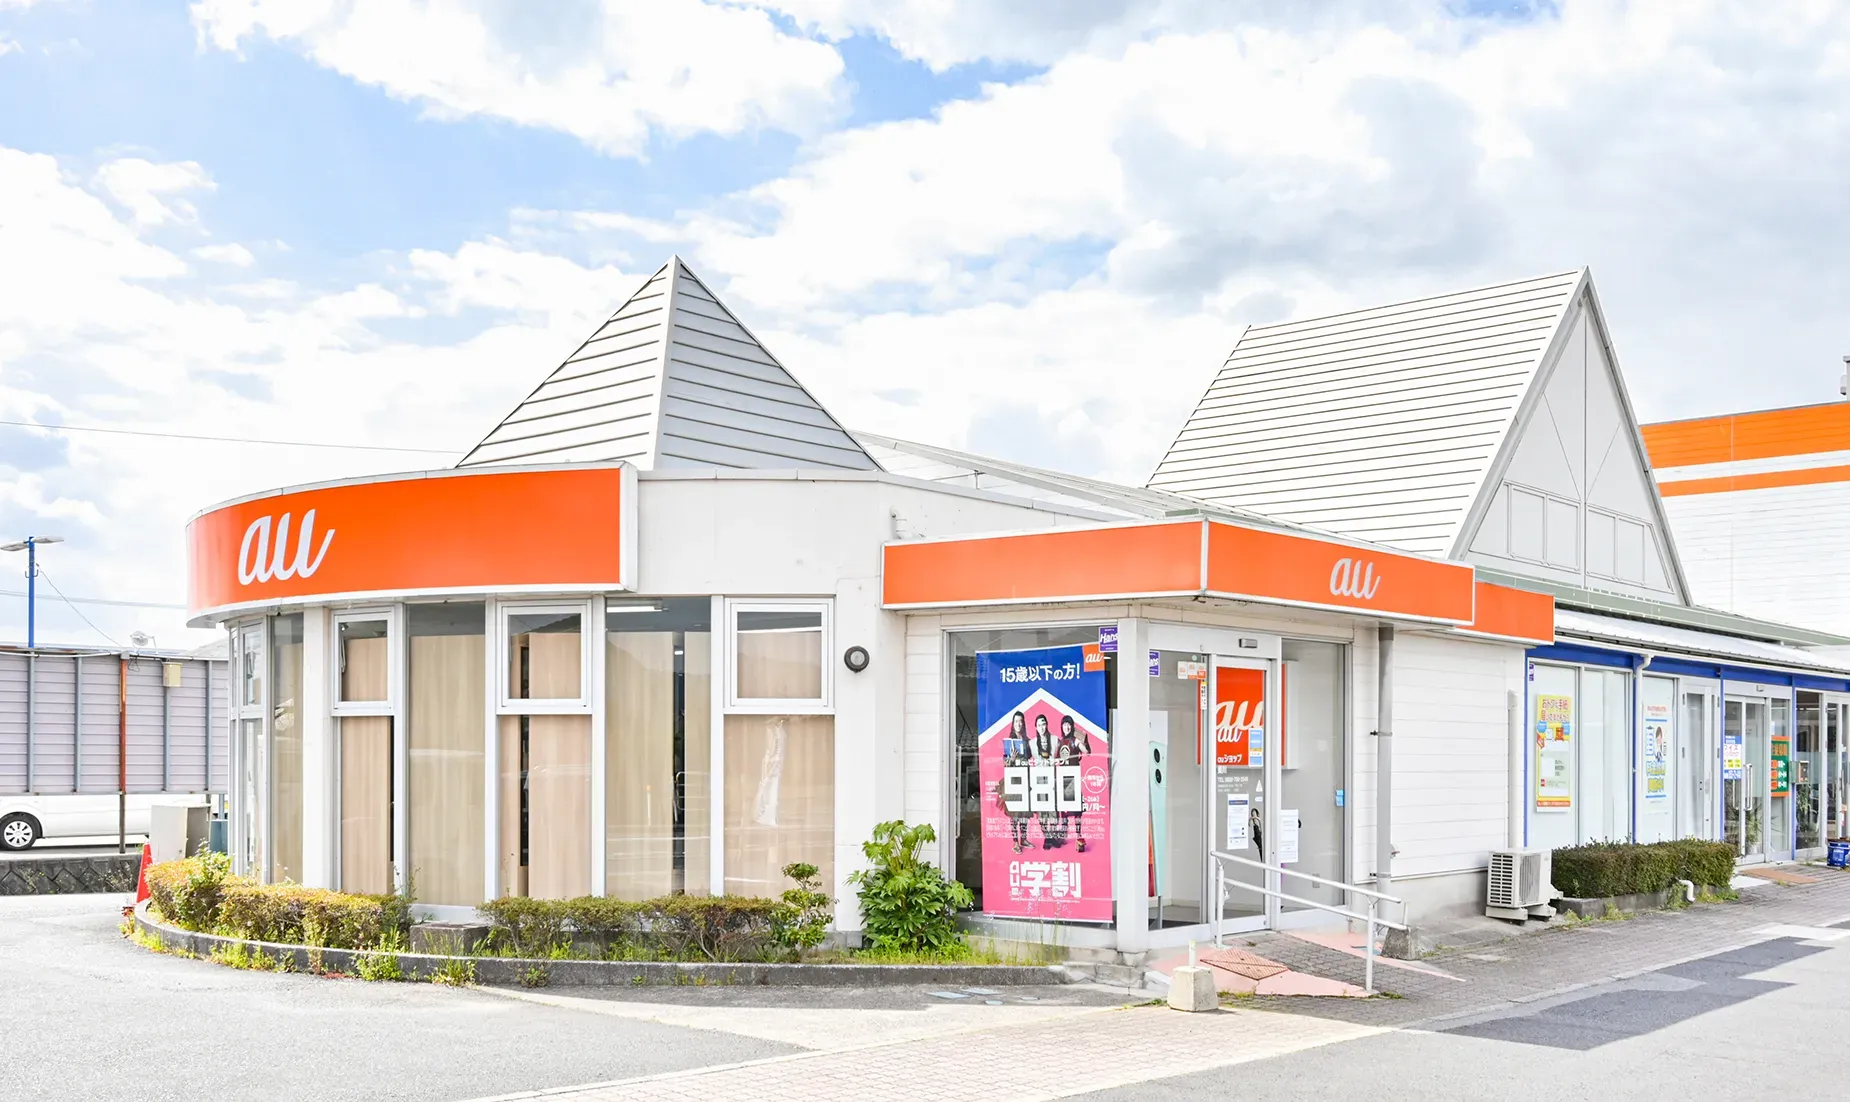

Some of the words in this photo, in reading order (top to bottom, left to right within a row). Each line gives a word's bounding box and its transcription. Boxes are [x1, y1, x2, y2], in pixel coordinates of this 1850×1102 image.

[238, 509, 336, 586] au
[1329, 557, 1381, 600] au
[1000, 662, 1081, 683] 15歳以下の方!
[1085, 651, 1105, 664] au
[1003, 766, 1081, 811] 980
